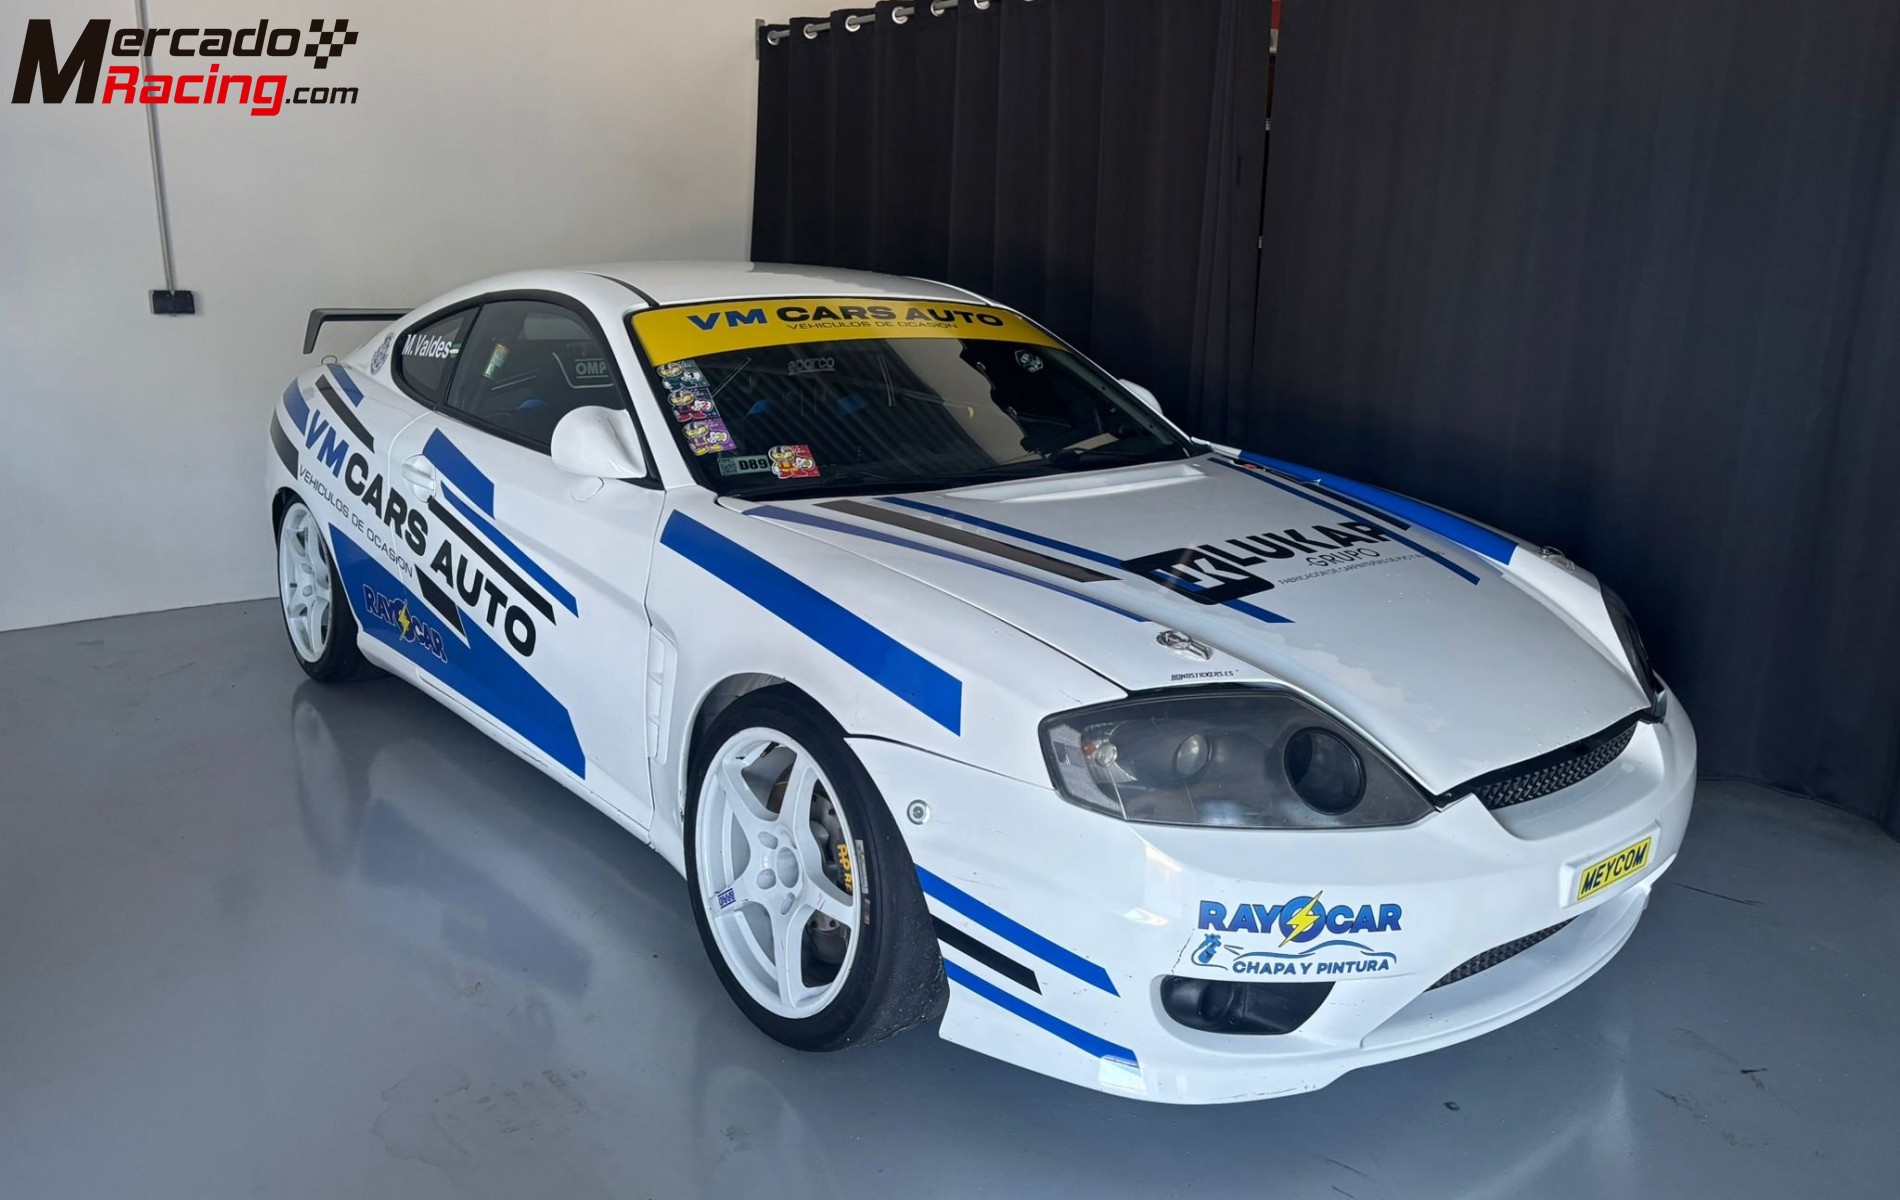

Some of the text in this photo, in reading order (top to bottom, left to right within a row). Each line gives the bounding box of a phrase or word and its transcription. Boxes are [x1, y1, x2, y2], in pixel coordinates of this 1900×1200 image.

[687, 305, 1004, 331] VM CARS AUTO
[876, 320, 895, 328] DE
[402, 334, 452, 359] M.Valdes
[575, 361, 607, 375] OMP
[300, 464, 349, 518] VEHICULOS
[352, 513, 364, 533] DE
[305, 409, 537, 657] VM CARS AUTO
[1581, 842, 1648, 894] MEYCOM
[1232, 959, 1389, 975] CHAPA Y PINTURA
